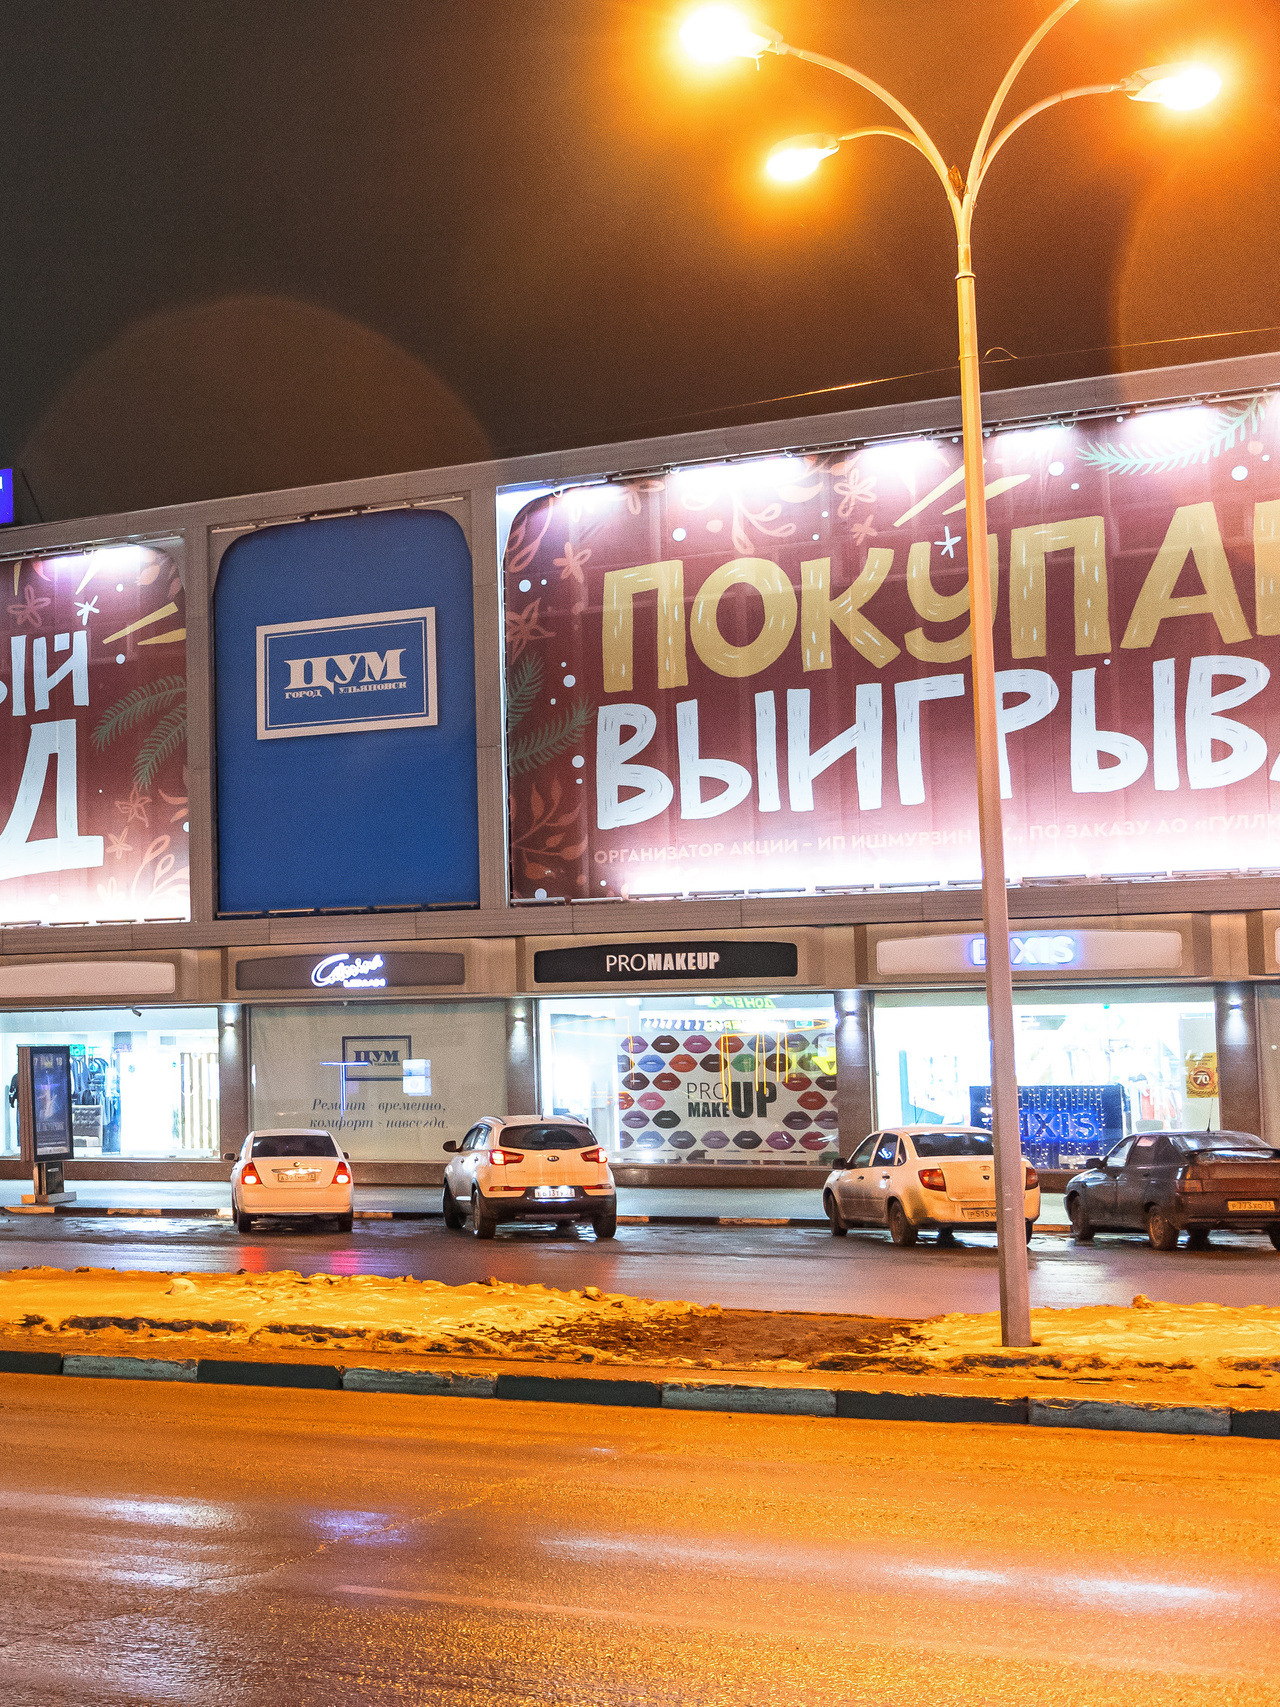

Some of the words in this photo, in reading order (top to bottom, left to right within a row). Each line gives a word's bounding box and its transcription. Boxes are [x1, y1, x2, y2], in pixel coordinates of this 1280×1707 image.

[283, 648, 407, 694] ЦУМ
[285, 689, 322, 699] ГОРОД
[339, 681, 407, 694] УЛЬЯНОВСК
[596, 655, 1280, 829] ВЫИГРЫВ
[594, 842, 726, 864] ОРГАНИЗАТОР
[729, 838, 799, 857] АКЦИИ
[818, 835, 846, 850] ИП
[852, 828, 972, 850] ИШМУРЗИН
[1029, 824, 1061, 841] ПО
[1066, 818, 1151, 839] ЗАКАЗУ
[1155, 817, 1188, 834] АО
[606, 951, 720, 972] PROMAKEUP
[353, 1050, 400, 1066] ЦУМ
[687, 1082, 729, 1100] PRO
[731, 1081, 778, 1119] UP
[688, 1102, 730, 1118] MAKE
[310, 1116, 373, 1131] комфорт
